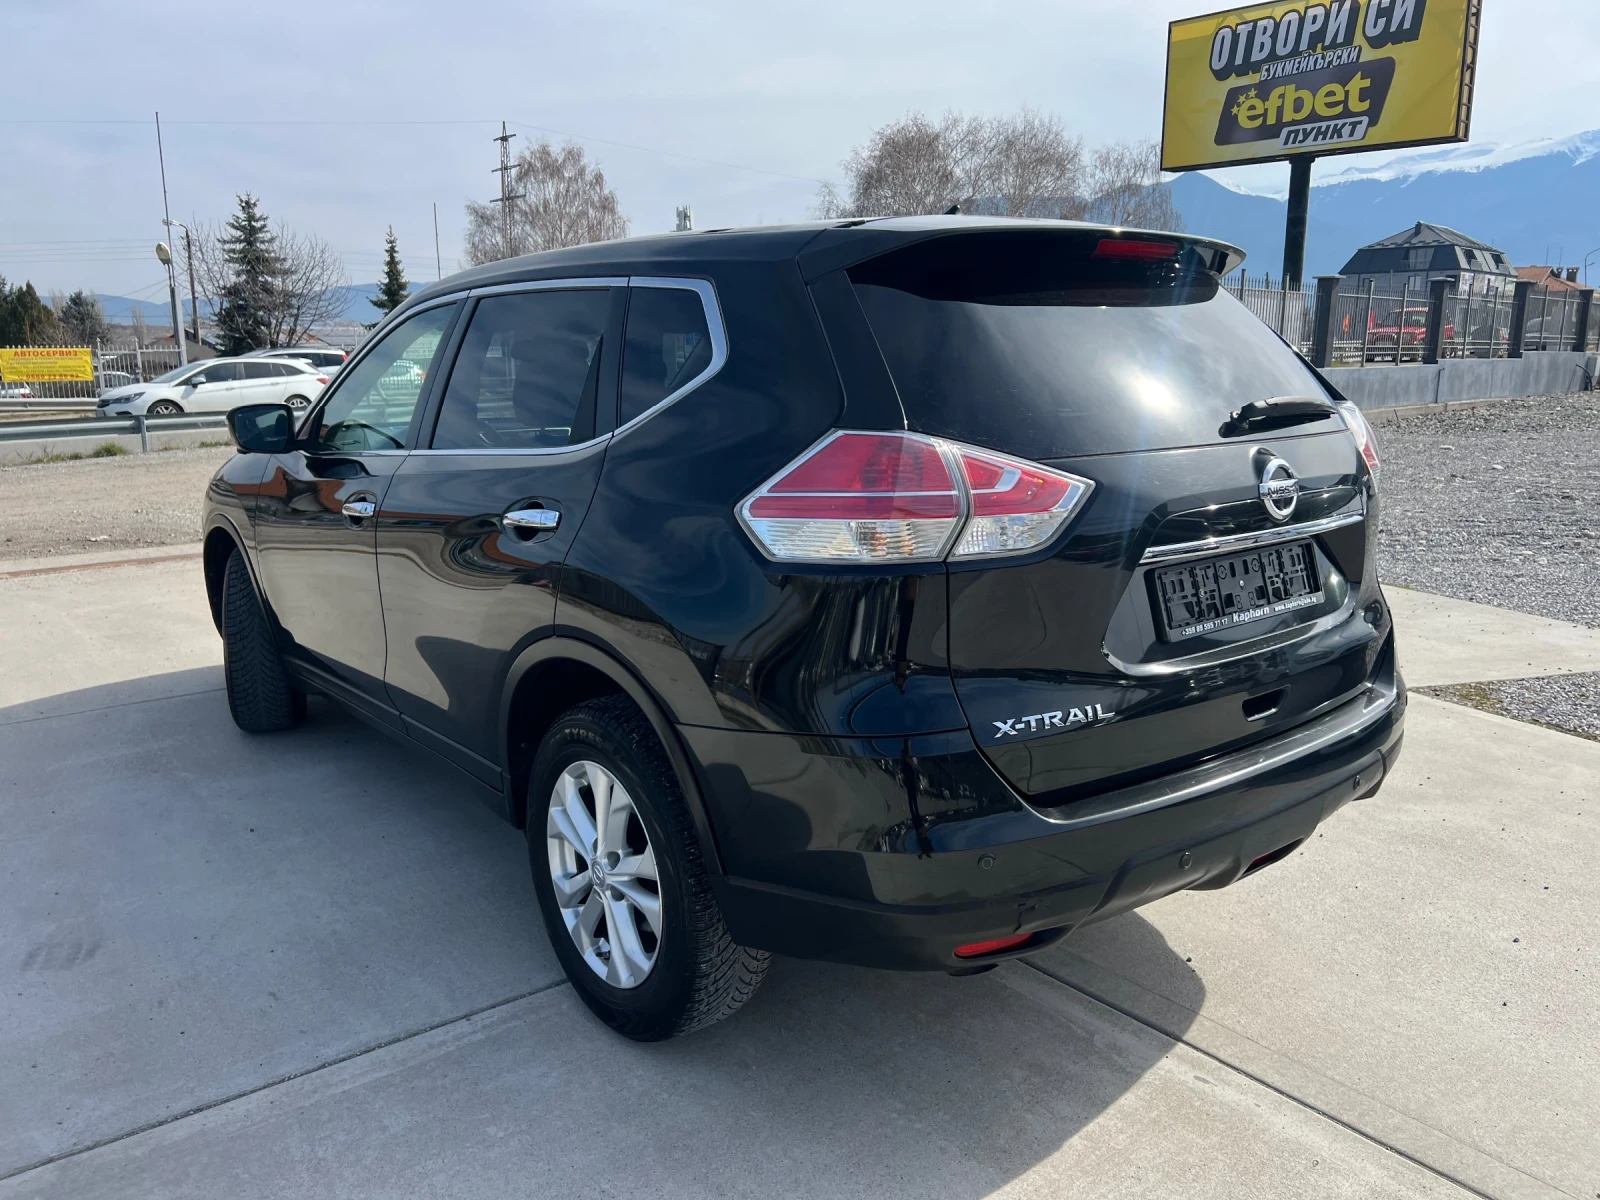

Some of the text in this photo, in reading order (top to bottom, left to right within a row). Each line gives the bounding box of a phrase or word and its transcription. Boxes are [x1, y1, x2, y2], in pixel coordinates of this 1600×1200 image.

[1210, 0, 1416, 71] ОТВОРИ СИ
[1260, 46, 1360, 81] БУКМЕЙКЪРСКИ
[1236, 71, 1371, 129] efbet
[1282, 120, 1364, 147] ПУНКТ
[1232, 606, 1270, 623] Kaphorn
[992, 703, 1116, 739] X-TRAIL
